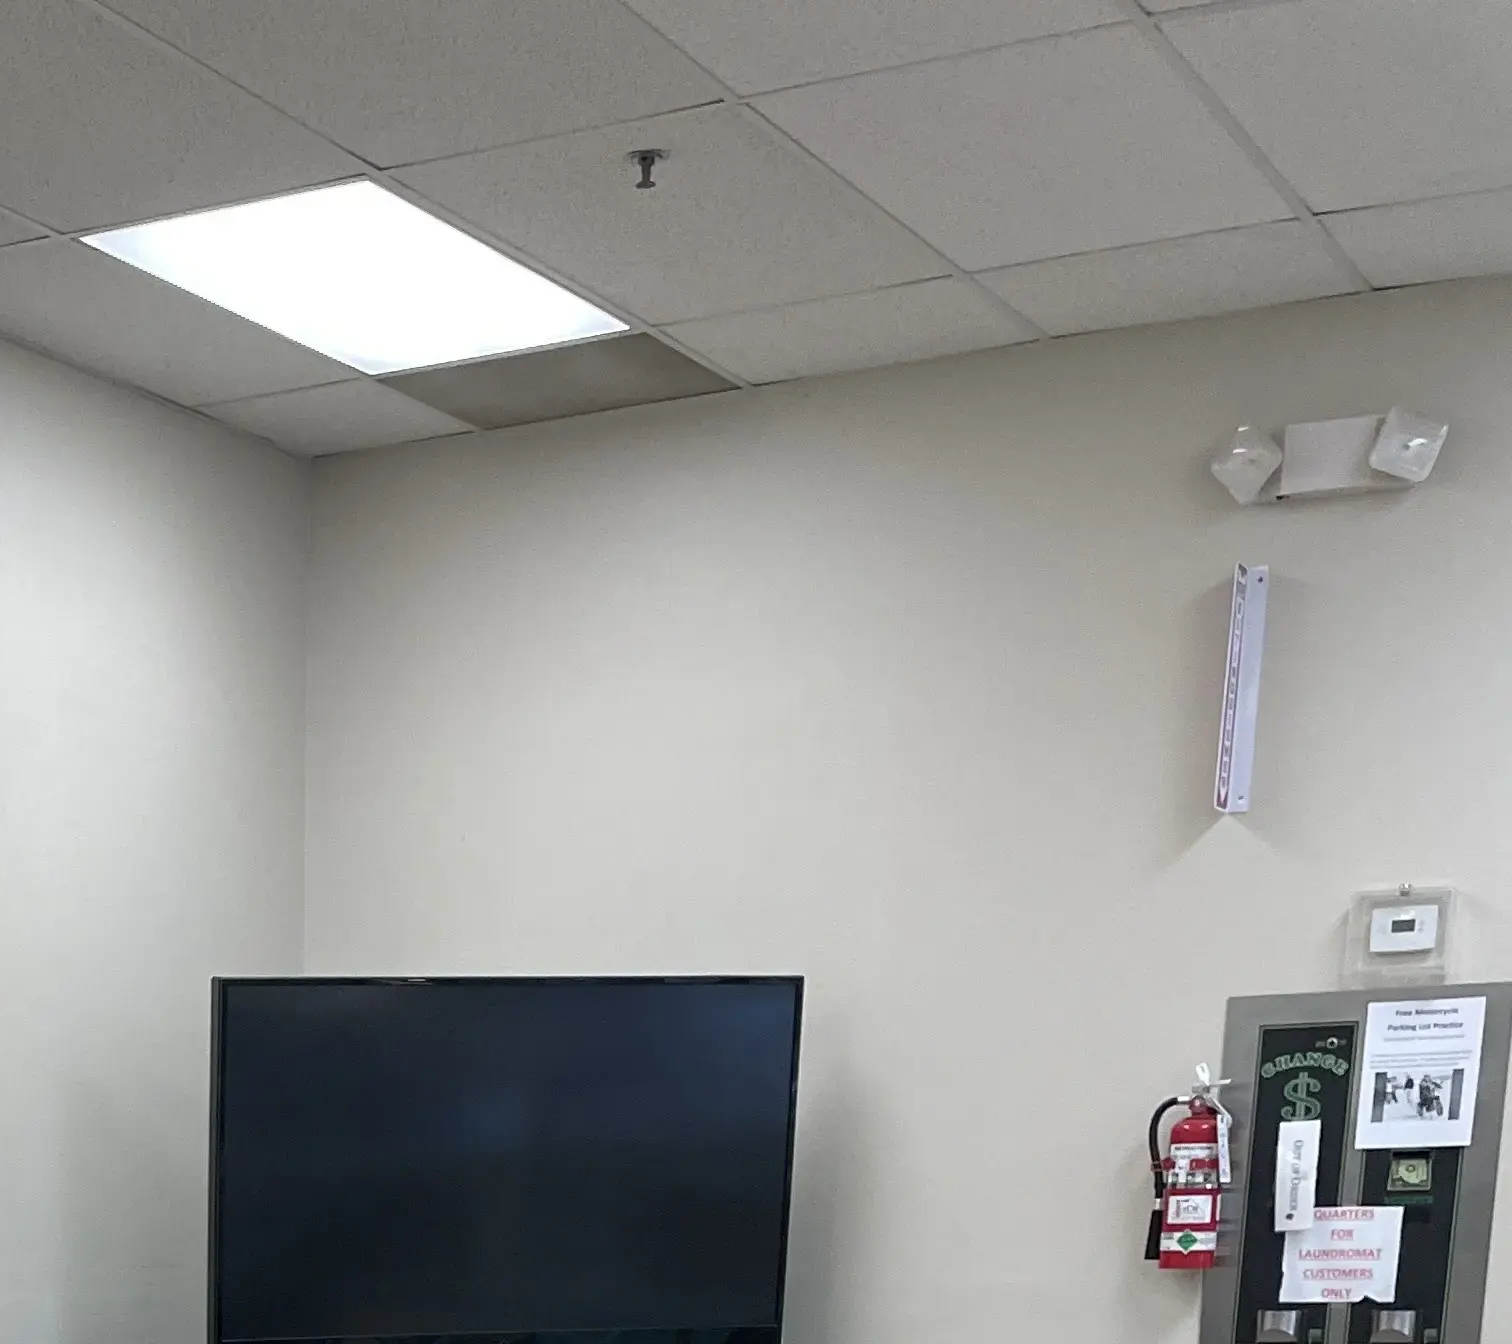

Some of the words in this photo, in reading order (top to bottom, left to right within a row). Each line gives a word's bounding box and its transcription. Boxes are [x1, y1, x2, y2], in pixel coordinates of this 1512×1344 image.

[1261, 1051, 1350, 1078] CHANGE
[1314, 1208, 1375, 1221] QUARTERS
[1330, 1229, 1354, 1241] FOR
[1299, 1248, 1382, 1261] LAUNDROMAT
[1302, 1268, 1374, 1281] CUSTOMERS
[1321, 1287, 1352, 1299] ONLY
